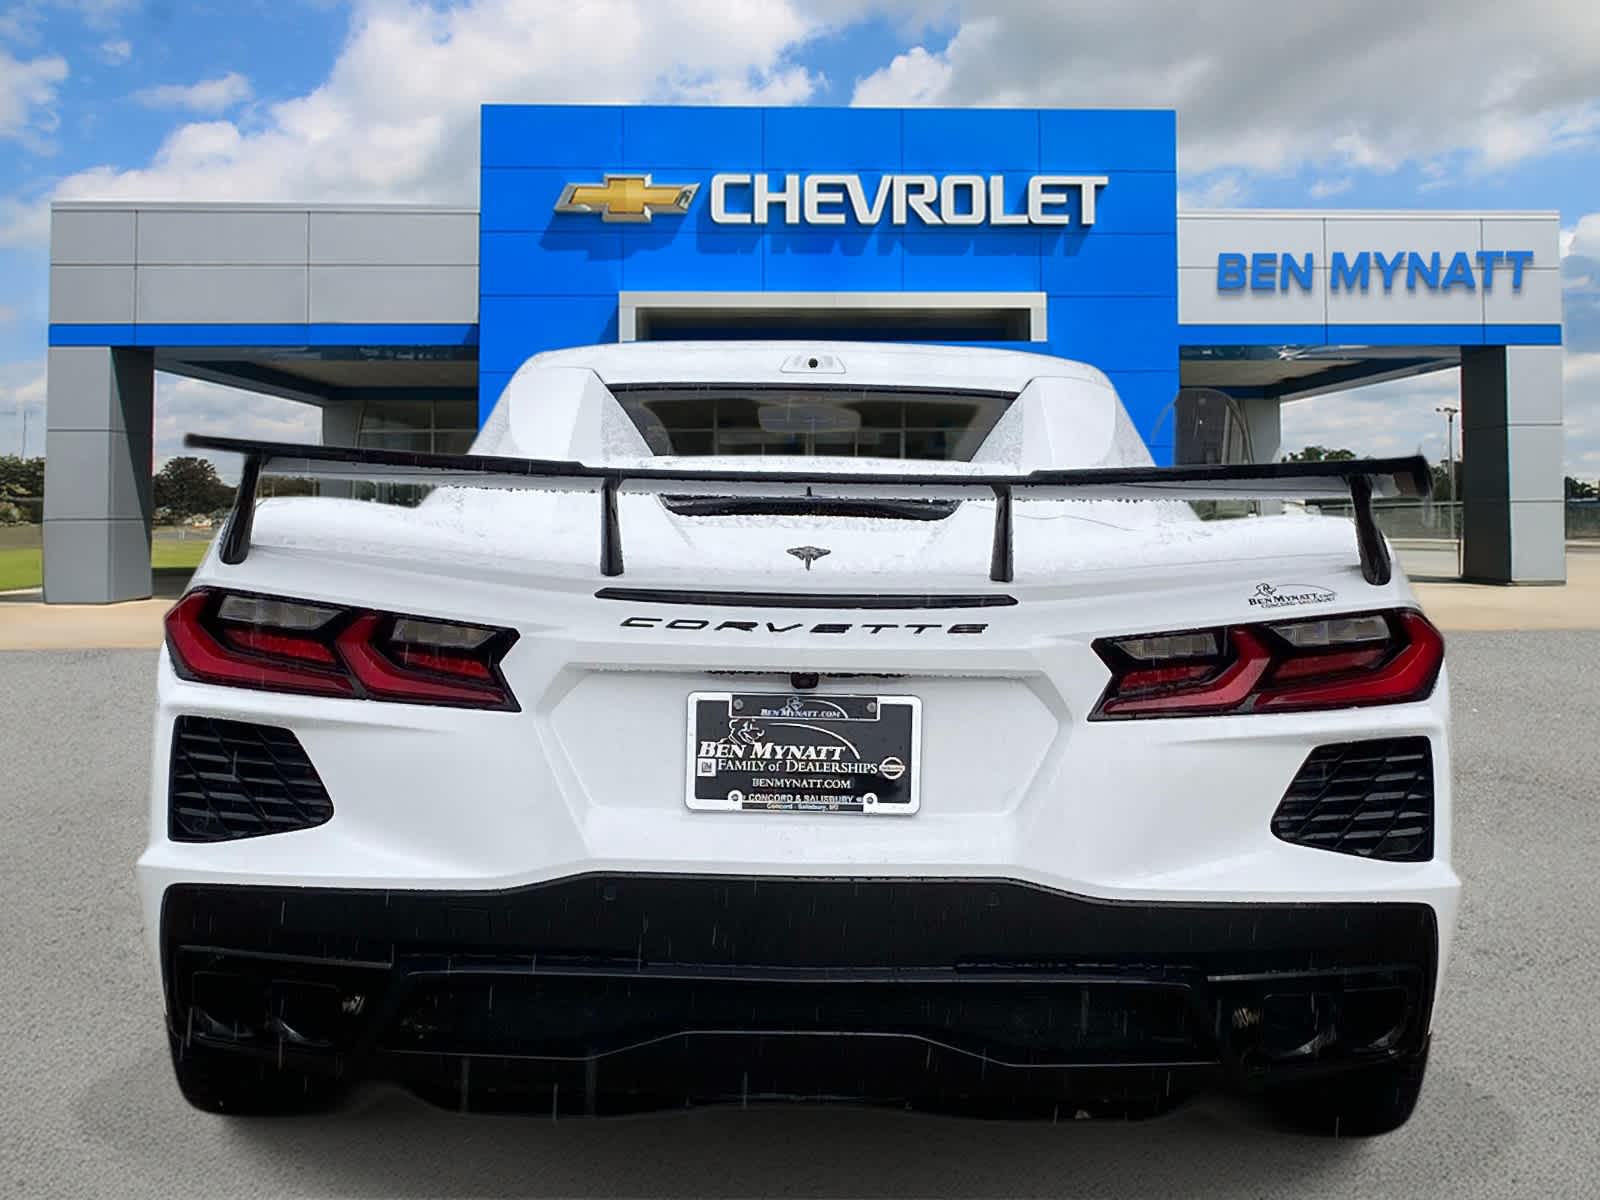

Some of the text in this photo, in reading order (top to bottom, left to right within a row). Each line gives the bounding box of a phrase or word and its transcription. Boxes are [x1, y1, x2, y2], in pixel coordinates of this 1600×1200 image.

[711, 173, 1109, 225] CHEVROLET
[1217, 250, 1534, 291] BEN MYNATT
[620, 616, 989, 634] CORVETTE
[698, 741, 846, 760] BEN MYNATT
[717, 759, 878, 774] FAMILY of DEALERSHIPS
[752, 778, 851, 789] BENMYNATT.COM
[748, 794, 793, 803] CONCORD
[803, 794, 853, 804] SALISBURY
